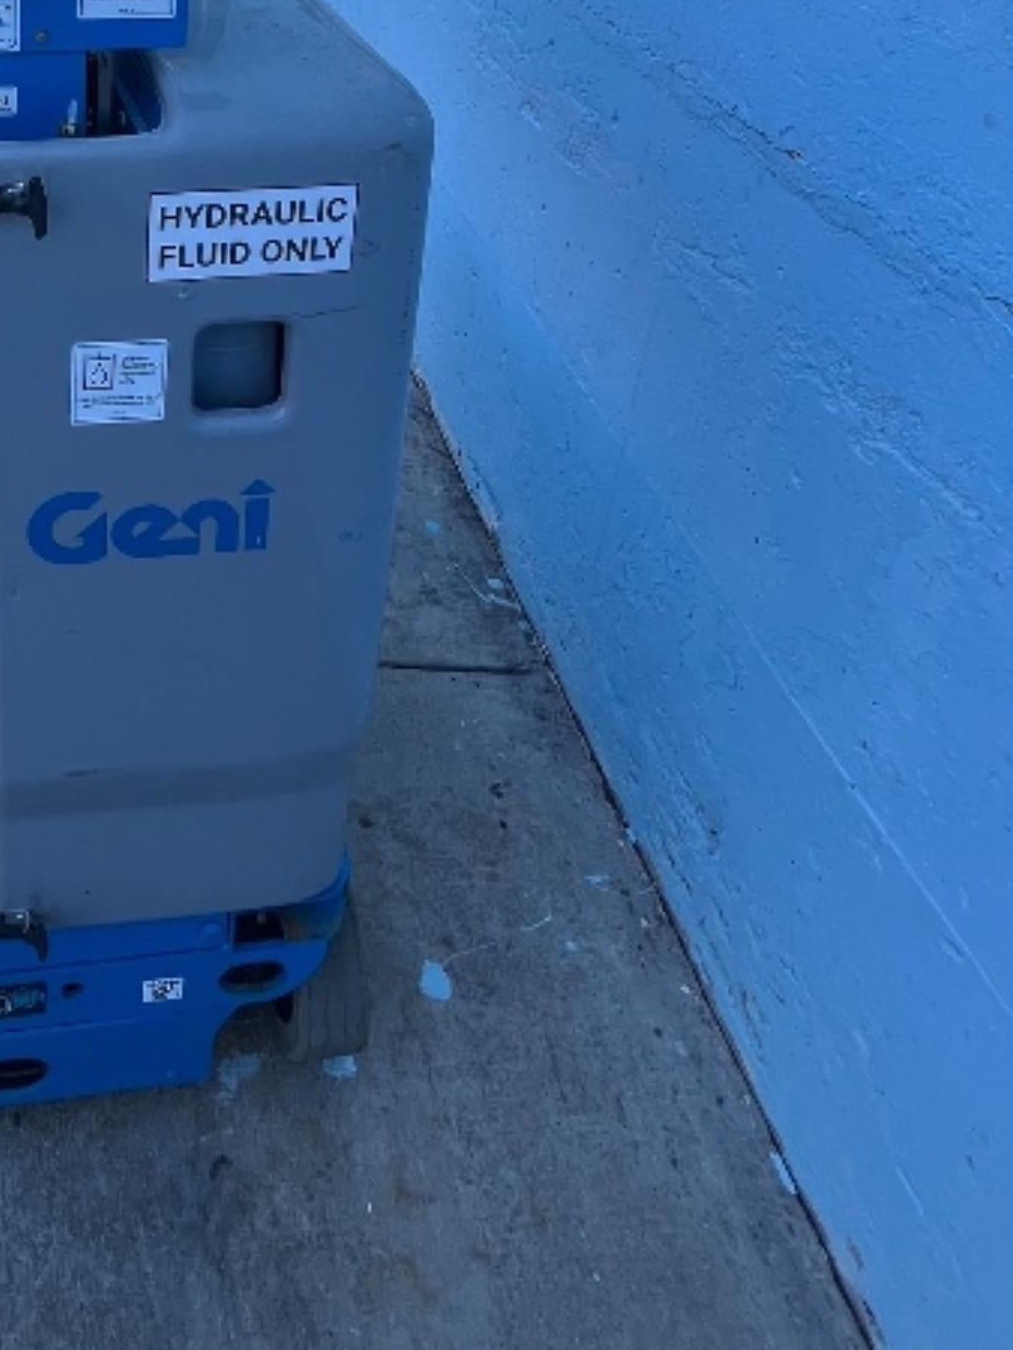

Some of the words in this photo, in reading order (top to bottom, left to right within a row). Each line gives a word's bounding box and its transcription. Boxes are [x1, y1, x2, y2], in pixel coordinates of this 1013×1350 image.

[159, 197, 349, 231] HYDRAULIC
[158, 241, 252, 269] FLUID
[260, 236, 343, 263] ONLY
